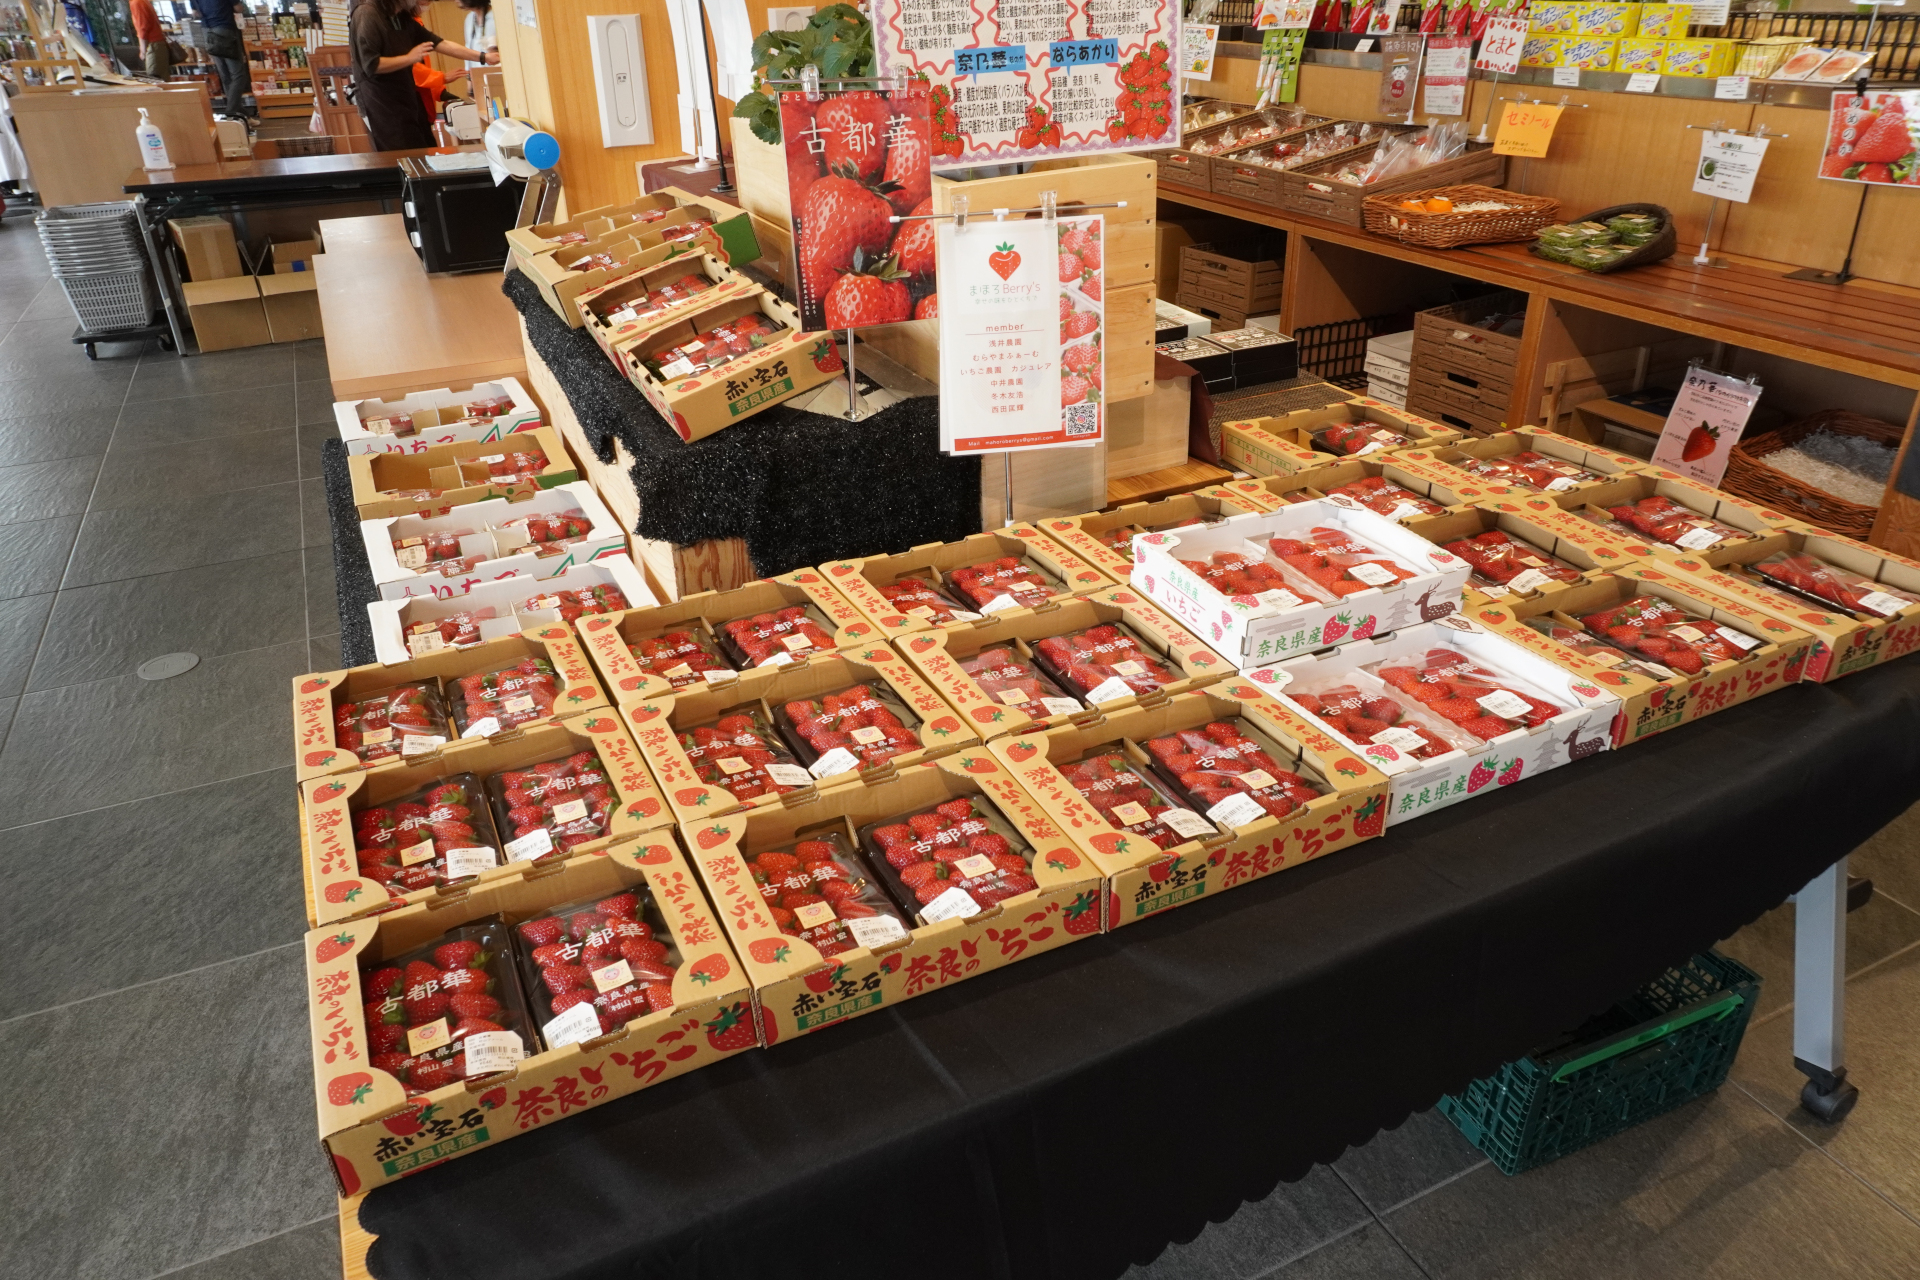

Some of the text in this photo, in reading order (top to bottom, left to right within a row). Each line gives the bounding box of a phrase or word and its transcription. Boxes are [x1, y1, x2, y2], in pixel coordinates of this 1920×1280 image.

[957, 51, 1007, 71] 奈乃華
[1053, 44, 1115, 63] ならあかり
[1485, 34, 1518, 57] とまと
[799, 113, 916, 157] 古都華
[1506, 111, 1552, 129] セミノール
[969, 281, 1041, 296] まほろ Berry's
[986, 323, 1025, 332] member
[989, 338, 1022, 348] 浅井農園
[709, 342, 786, 380] 奈良のいちご
[960, 363, 1052, 375] いちご農園 カジュレア
[972, 350, 1039, 361] むらやまふぁーむ
[725, 360, 789, 401] 赤い宝石
[735, 378, 789, 413] 奈良県産
[990, 378, 1023, 387] 中井農園
[1549, 512, 1626, 544] 奈良のいちご
[1030, 539, 1086, 569] 奈良のいちご
[1064, 532, 1121, 563] 奈良のいちご
[1310, 541, 1367, 558] 古都華
[979, 564, 1033, 583] 古都華
[1206, 558, 1264, 578] 古都華
[840, 578, 892, 614] 奈良のいちご
[1169, 569, 1199, 602] 奈良県産
[1666, 580, 1758, 617] 奈良のいちご
[1704, 572, 1798, 611] 奈良のいちご
[807, 586, 860, 620] 奈良のいちご
[1166, 589, 1201, 624] いちご
[1626, 599, 1677, 628] 古都華
[753, 616, 813, 639] 古都華
[1129, 607, 1197, 647] 奈良のいちご
[1256, 625, 1323, 659] 奈良県産
[551, 642, 592, 682] 奈良のいちご
[592, 633, 635, 675] 奈良のいちご
[635, 643, 697, 666] 古都華
[1075, 637, 1135, 660] 古都華
[1505, 626, 1597, 669] 奈良のいちご
[1840, 635, 1884, 663] 赤い宝石
[479, 675, 547, 700] 古都華
[882, 665, 945, 712] 奈良のいちご
[922, 655, 983, 704] 奈良のいちご
[1421, 661, 1479, 685] 古都華
[1692, 651, 1788, 719] 奈良のいちご
[300, 696, 329, 746] 奈良のいちご
[815, 698, 883, 725] 古都華
[1322, 692, 1383, 717] 古都華
[1636, 694, 1687, 726] 赤い宝石
[1255, 703, 1341, 753] 奈良のいちご
[600, 738, 652, 792] 奈良のいちご
[638, 727, 693, 783] 奈良のいちご
[1195, 741, 1262, 769] 古都華
[524, 772, 603, 798] 古都華
[719, 769, 767, 786] 奈良県産
[1398, 774, 1469, 815] 奈良県産
[985, 779, 1061, 840] 奈良のいちご
[1023, 766, 1101, 828] 奈良のいちご
[313, 808, 352, 875] 奈良のいちご
[370, 807, 454, 843] 古都華
[909, 819, 987, 854] 古都華
[1221, 804, 1354, 891] 奈良のいちご
[705, 854, 770, 931] 奈良のいちご
[758, 864, 839, 898] 古都華
[958, 868, 1010, 890] 奈良県産
[1134, 863, 1208, 904] 赤い宝石
[652, 871, 718, 946] 奈良のいちご
[1142, 882, 1200, 914] 奈良県産
[554, 922, 646, 962] 古都華
[799, 917, 850, 940] 奈良県産
[900, 900, 1060, 997] 奈良のいちご
[374, 967, 473, 1016] 古都華
[592, 980, 654, 1008] 奈良県産
[610, 999, 632, 1013] 村山
[790, 970, 883, 1018] 赤い宝石
[314, 969, 361, 1065] 奈良のいちご
[805, 992, 875, 1028] 奈良県産
[396, 1040, 467, 1070] 奈良県産
[416, 1063, 440, 1076] 村山
[511, 1017, 701, 1131] 奈良のいちご
[373, 1106, 487, 1163] 赤い宝石
[393, 1130, 480, 1175] 奈良県産
